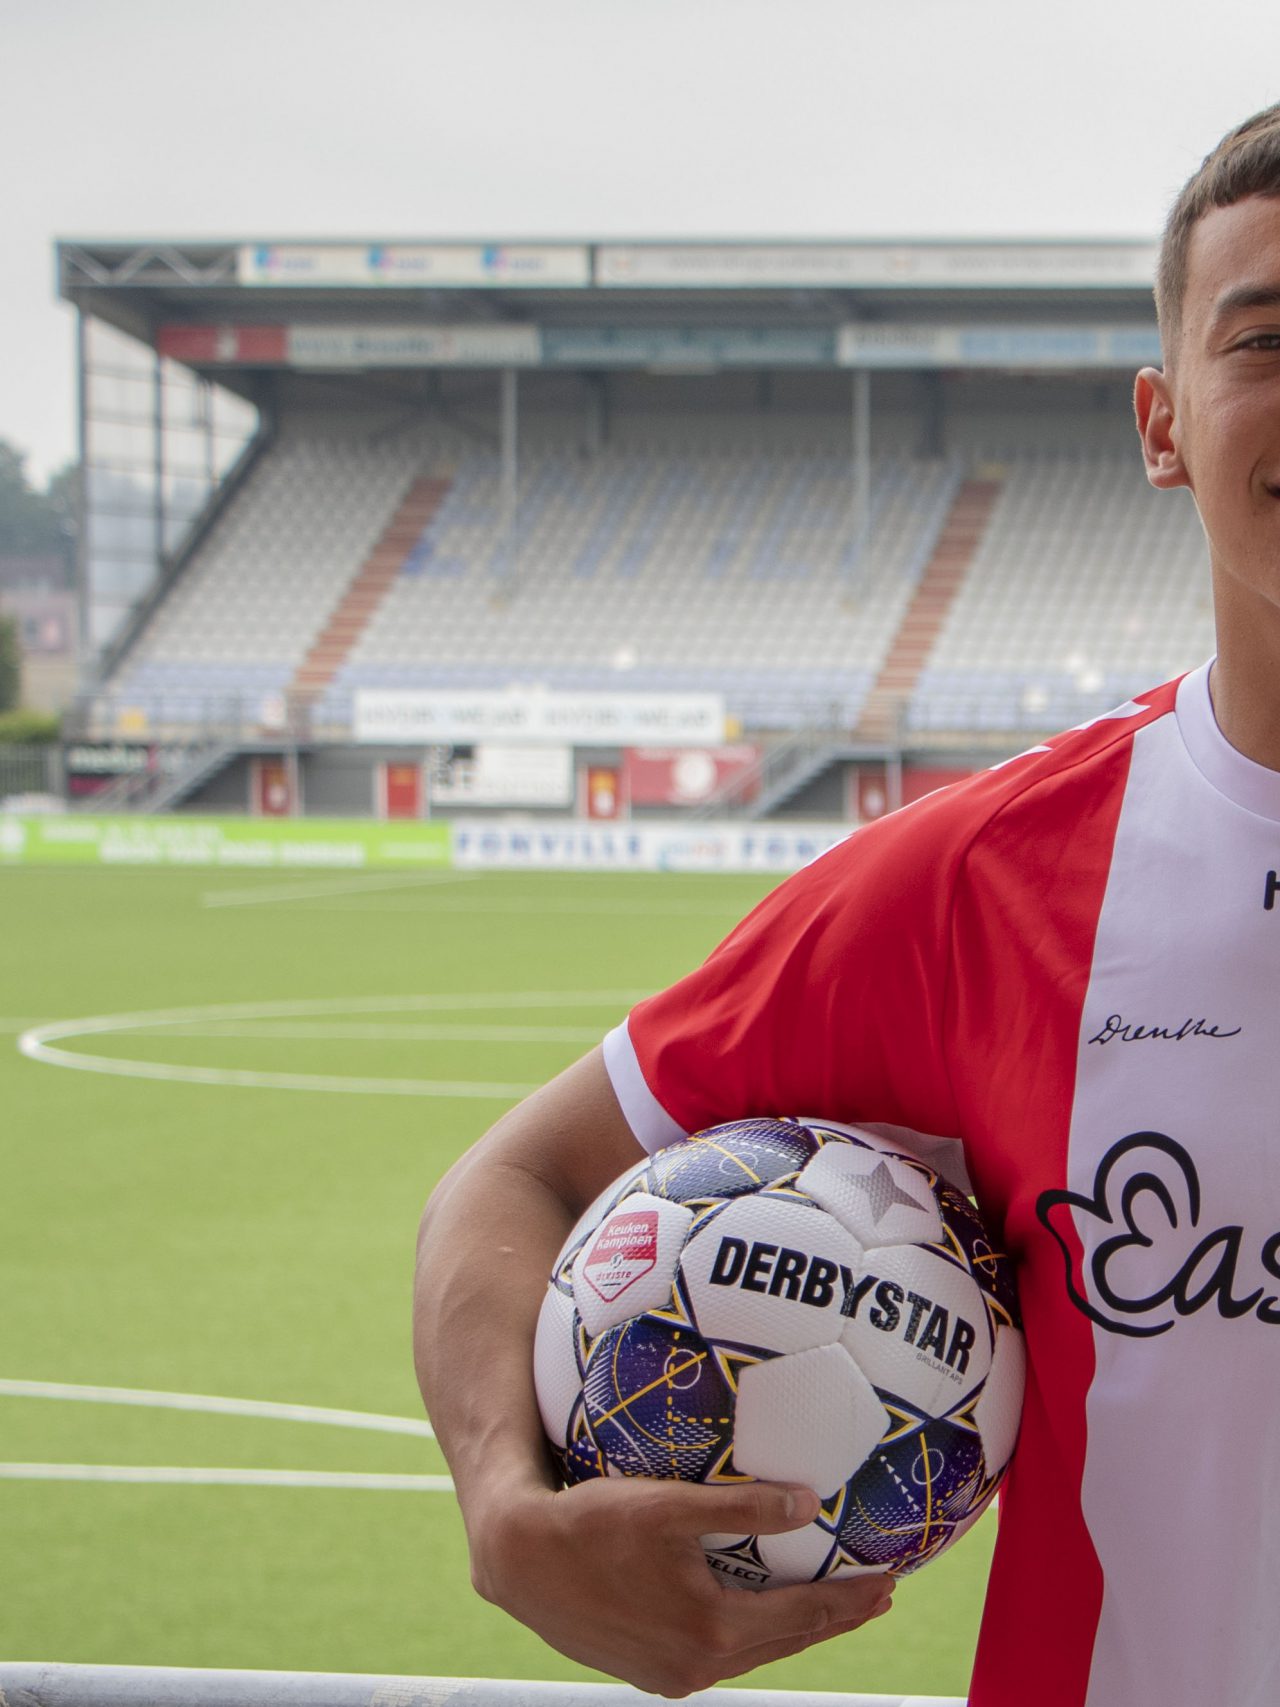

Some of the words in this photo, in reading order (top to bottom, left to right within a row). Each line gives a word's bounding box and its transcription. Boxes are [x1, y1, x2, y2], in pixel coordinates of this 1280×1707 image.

[456, 830, 642, 859] FONVILLE
[607, 1222, 649, 1237] Keuken
[596, 1235, 653, 1251] Kampioen
[709, 1236, 976, 1375] DERBYSTAR
